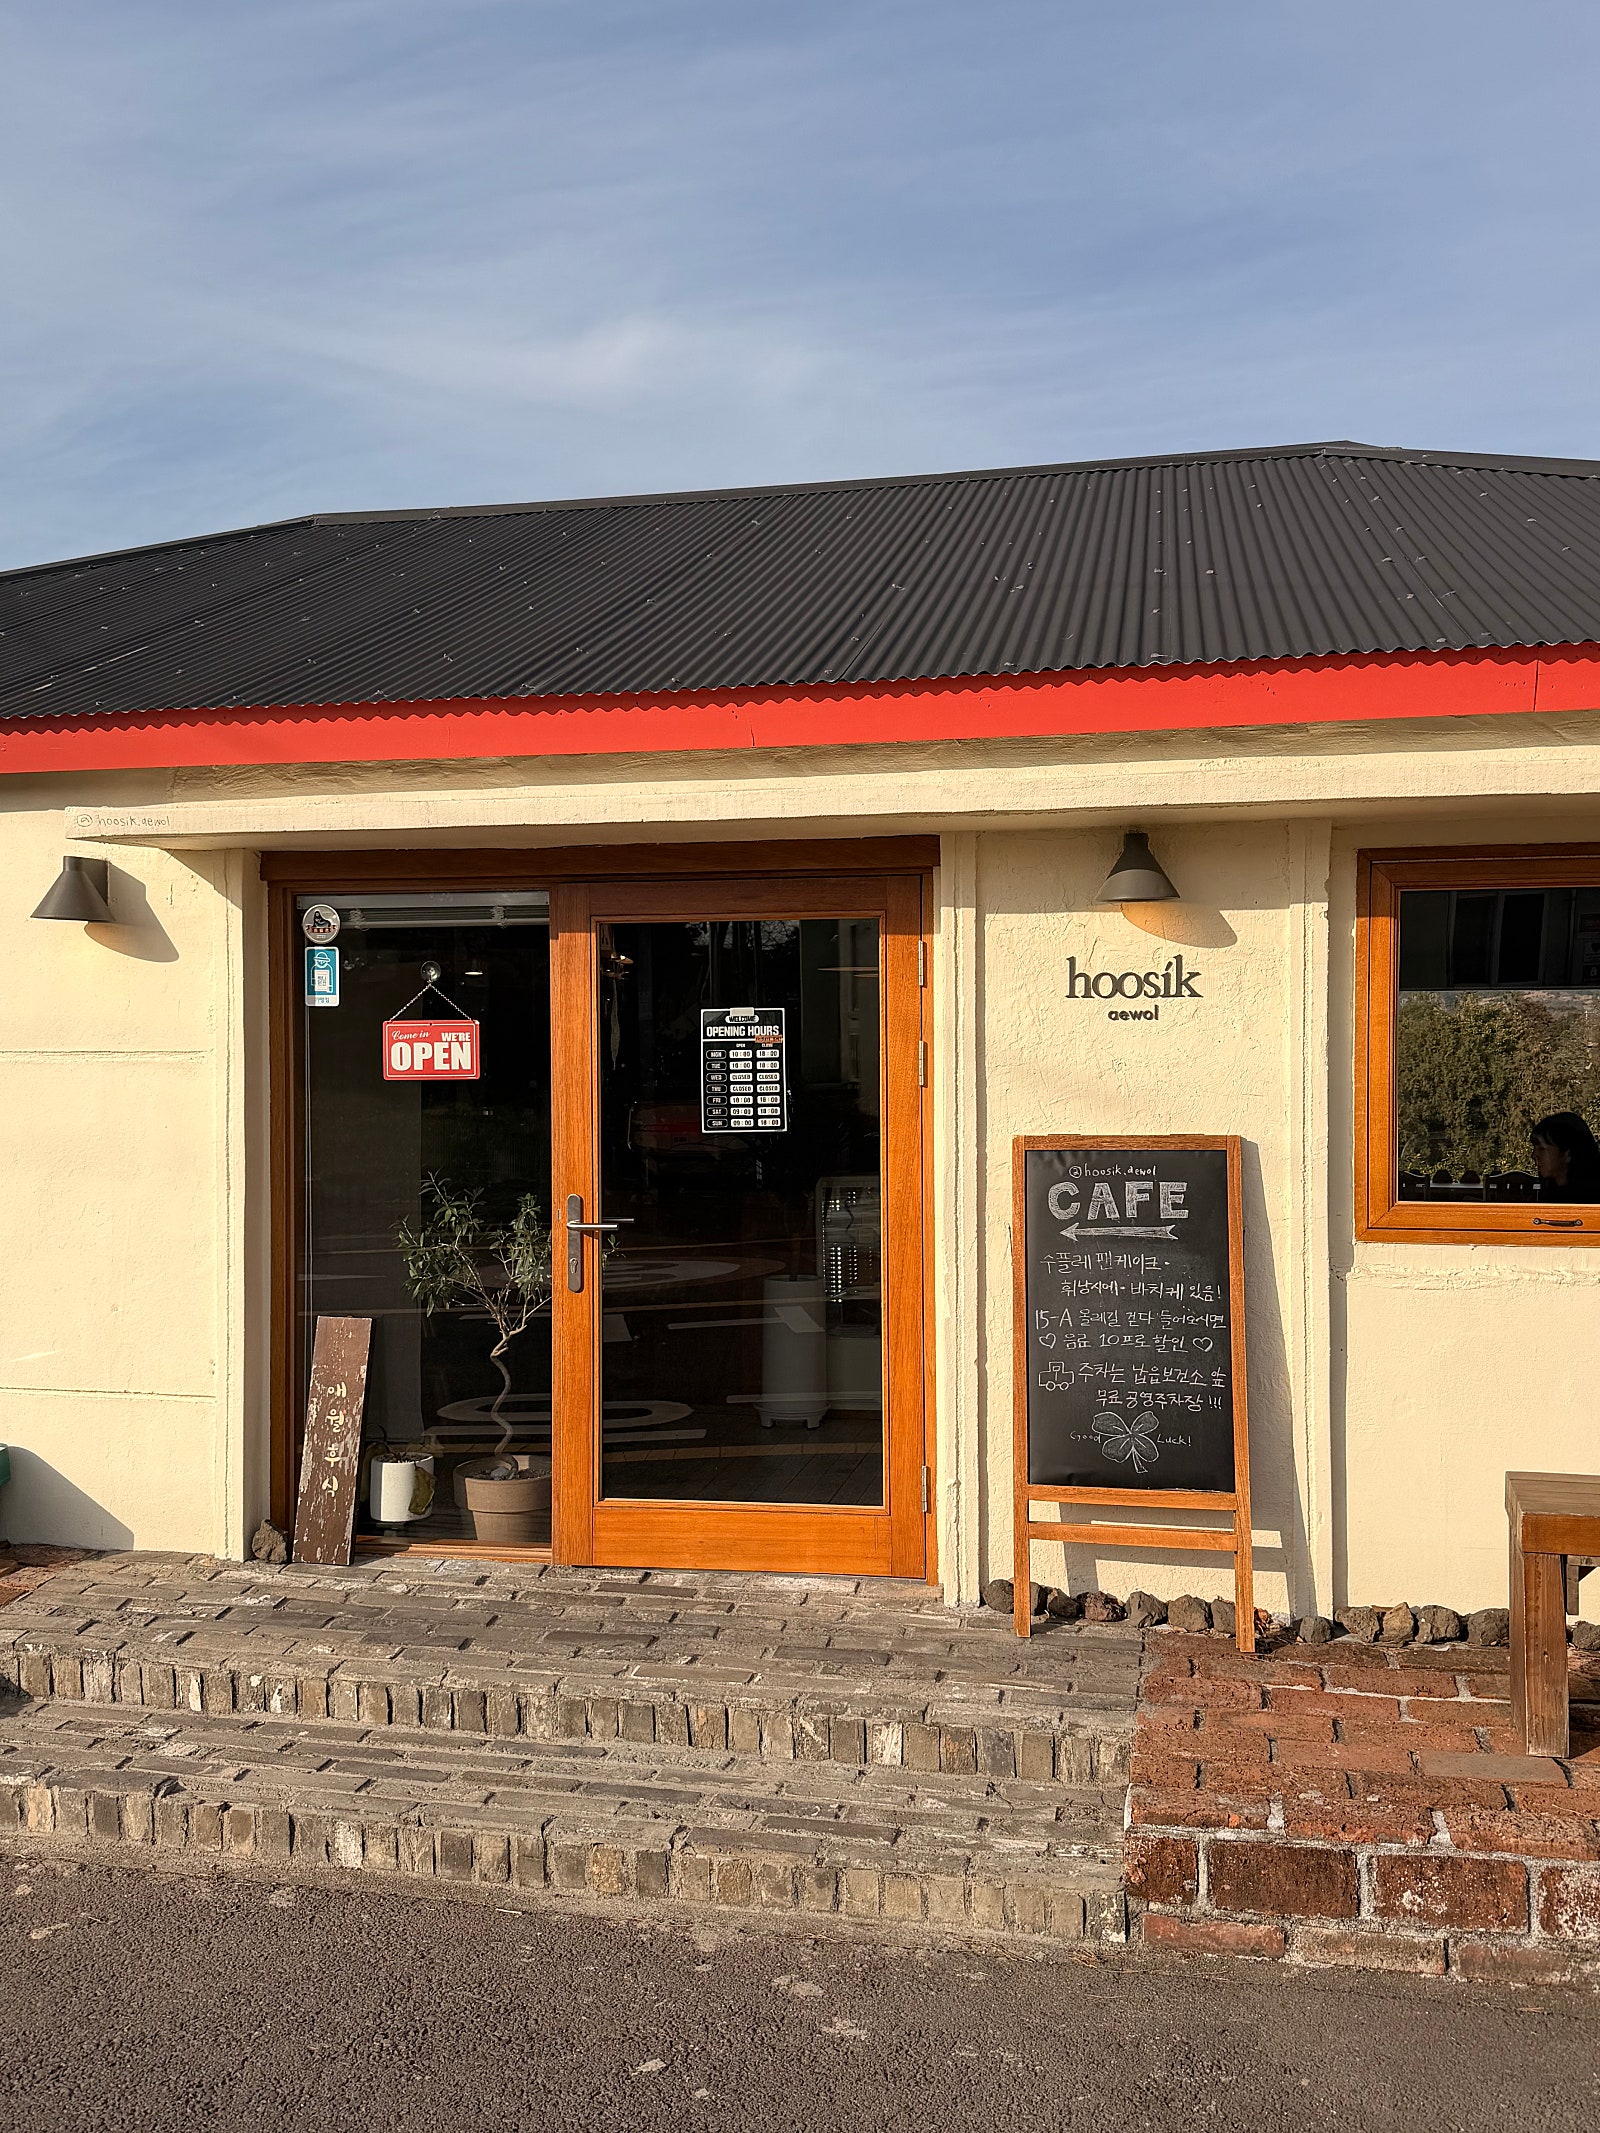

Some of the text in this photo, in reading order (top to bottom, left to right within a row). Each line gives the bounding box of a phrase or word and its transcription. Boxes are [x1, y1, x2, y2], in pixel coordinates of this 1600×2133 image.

[1107, 1004, 1159, 1021] aewol
[391, 1030, 430, 1040] Come in
[441, 1032, 471, 1042] WE'RE
[706, 1025, 780, 1037] OPENING HOURS
[390, 1042, 472, 1071] OPEN
[1068, 1163, 1157, 1178] @hoosik.aewol
[1048, 1181, 1189, 1221] CAFE
[1040, 1252, 1092, 1274] 수플레
[1189, 1283, 1221, 1302] 있음!
[1035, 1308, 1227, 1330] 15-A 올레길 걷다 들어오시면
[1063, 1333, 1092, 1350] 음료
[1152, 1334, 1188, 1353] 할인
[1078, 1361, 1126, 1383] 주차는
[1211, 1366, 1227, 1388] 앞
[1095, 1389, 1123, 1407] 무료
[321, 1380, 347, 1498] 애월후식
[1069, 1430, 1191, 1447] Good Luck!
